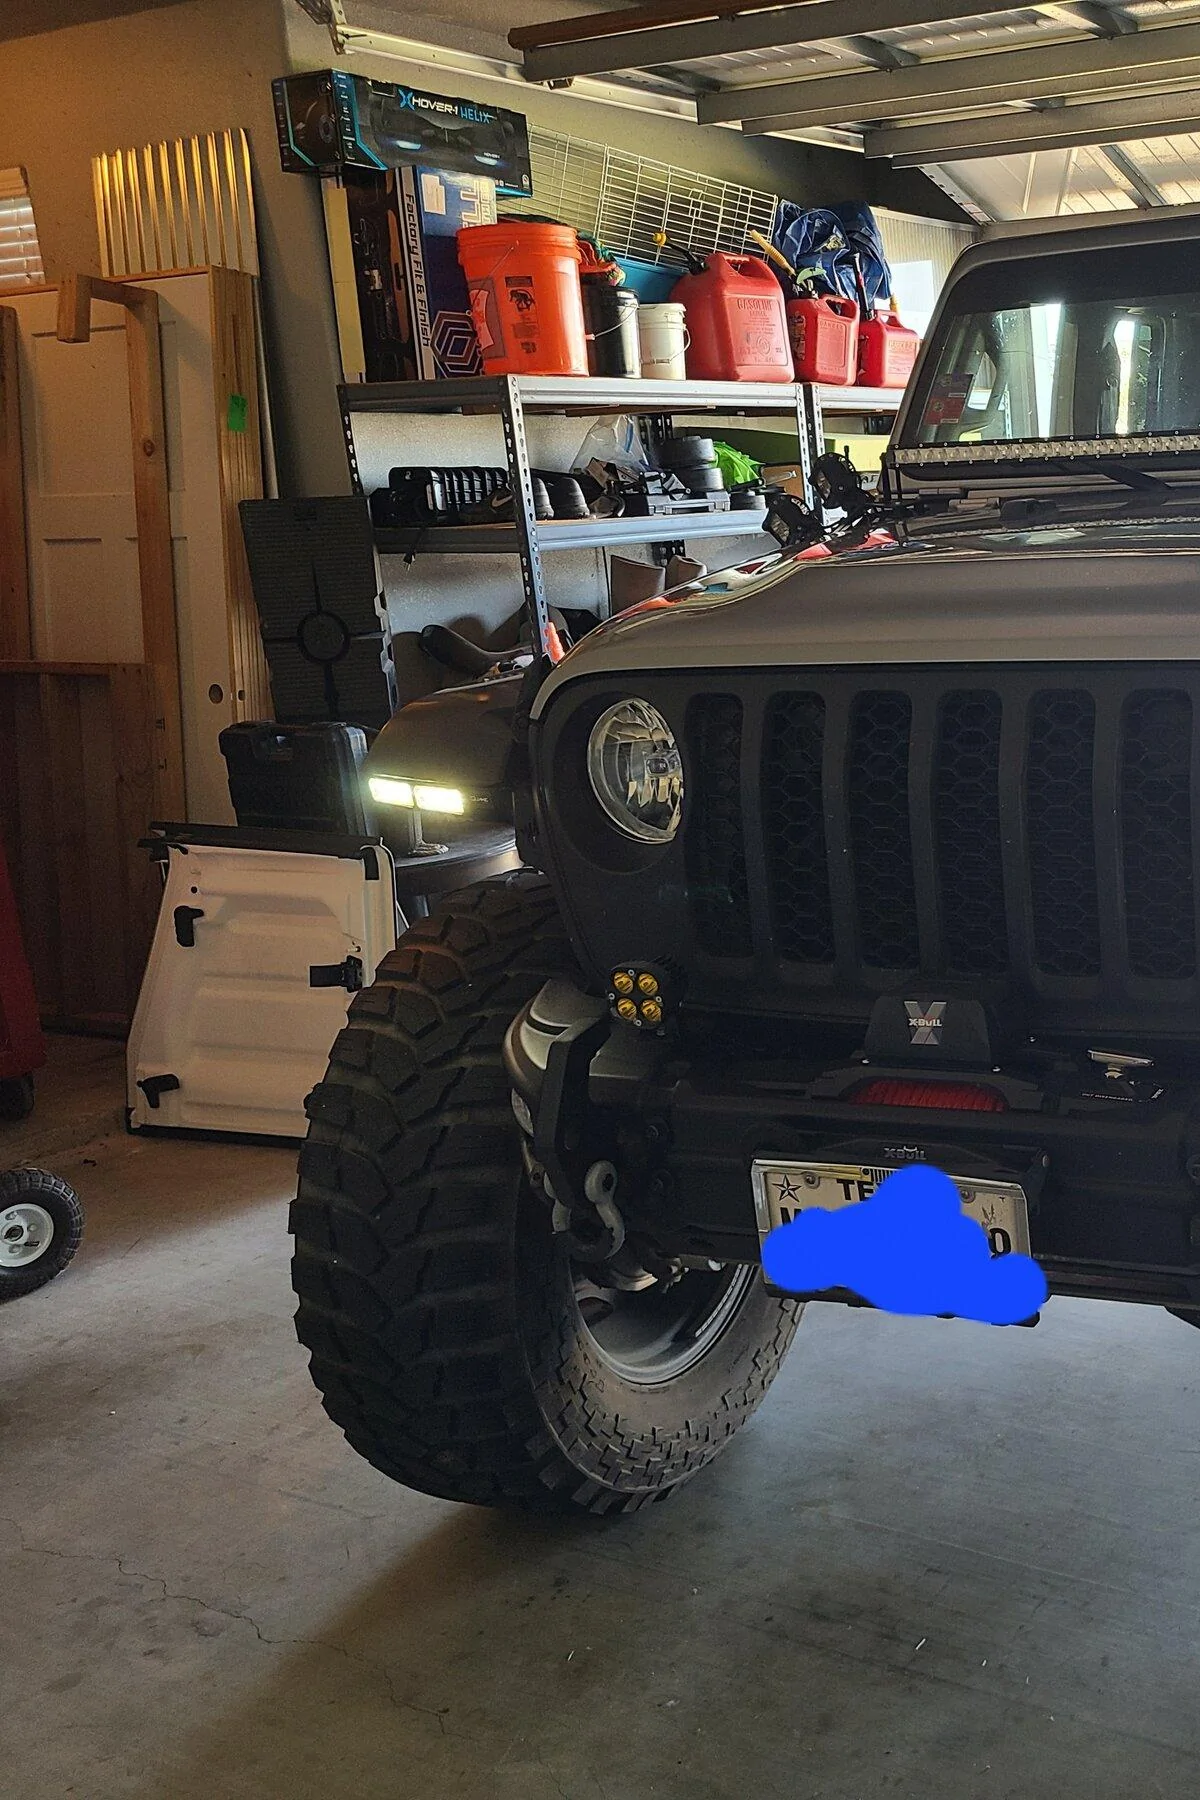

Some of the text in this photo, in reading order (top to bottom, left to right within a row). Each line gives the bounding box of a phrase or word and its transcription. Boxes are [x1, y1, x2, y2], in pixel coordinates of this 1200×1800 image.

[412, 96, 494, 124] HOVER-1 HELIX
[405, 193, 419, 256] Factory
[412, 260, 424, 280] Fit
[418, 299, 431, 346] Finish
